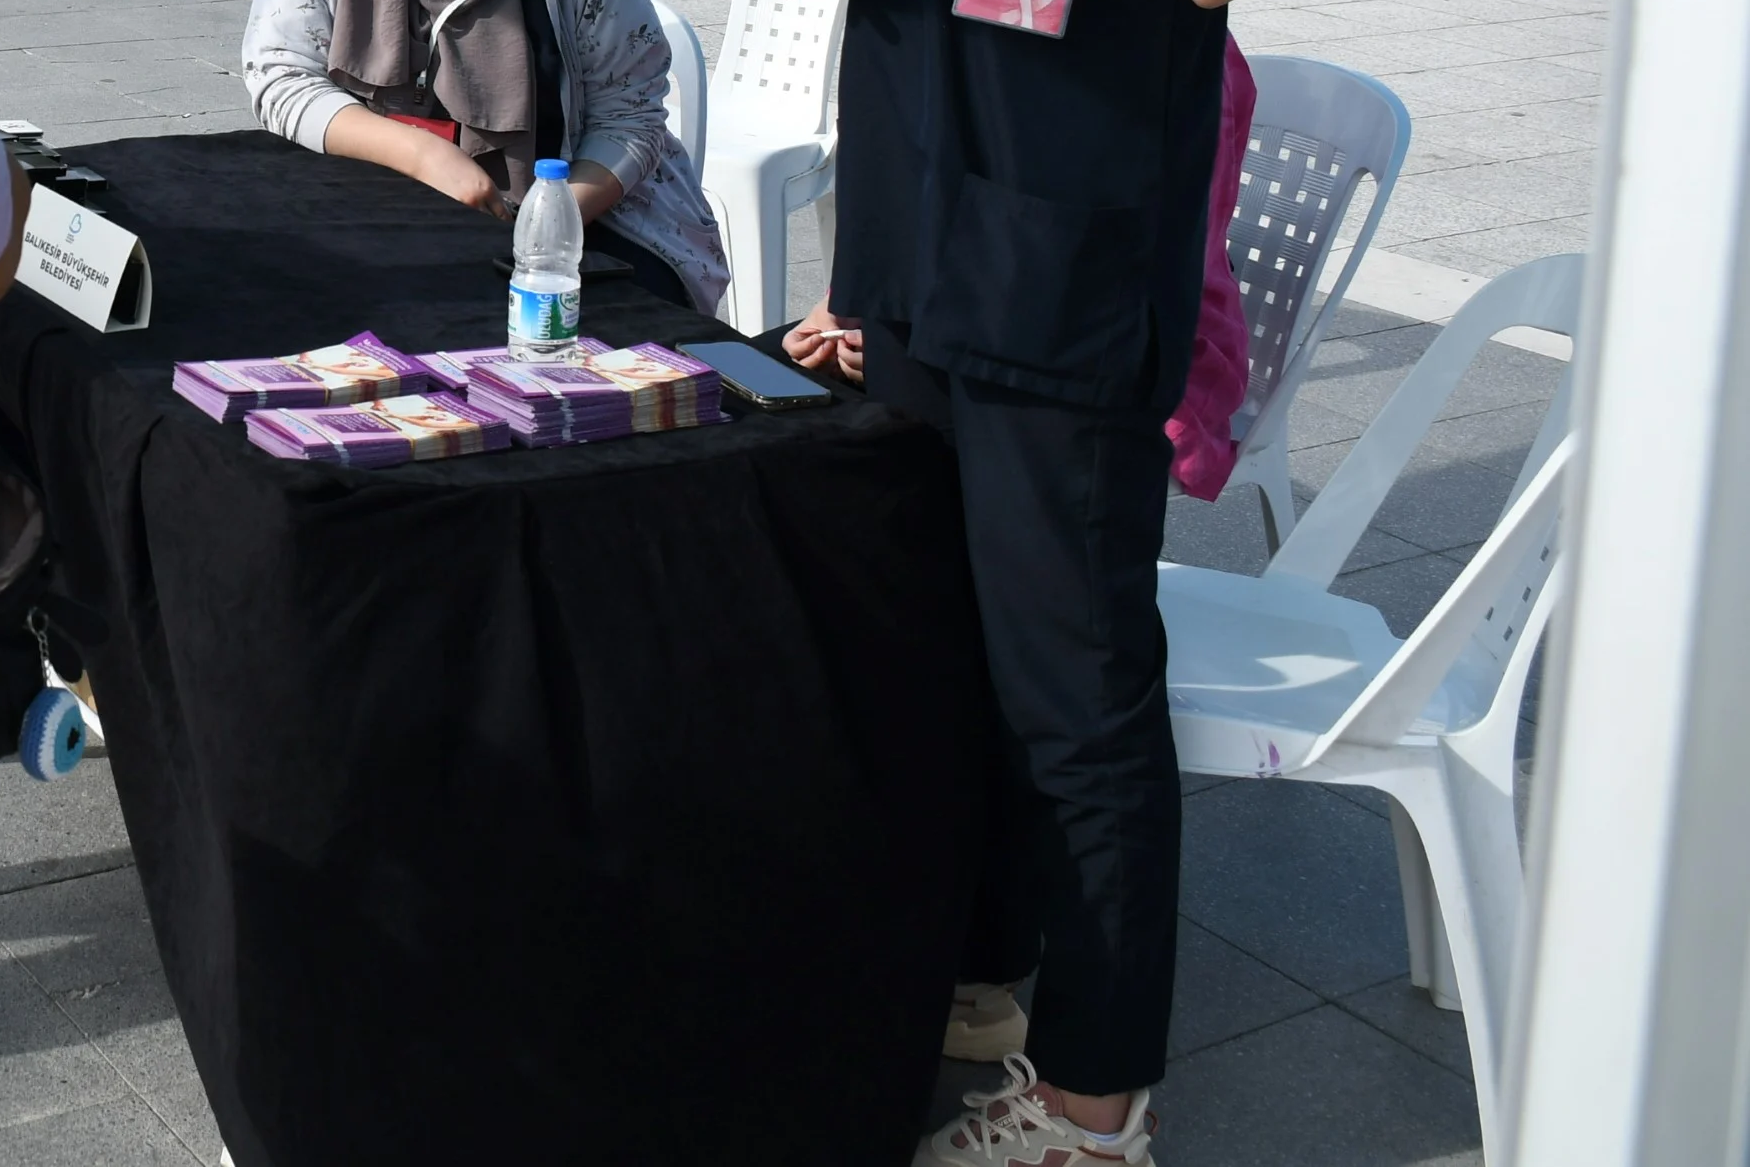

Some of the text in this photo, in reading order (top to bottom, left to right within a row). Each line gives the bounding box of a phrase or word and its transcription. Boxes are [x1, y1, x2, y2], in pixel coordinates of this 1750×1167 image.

[24, 231, 110, 289] BALIKESİR BÜYÜKŞEHİR
[39, 258, 84, 292] BELEDİYESİ
[536, 293, 553, 339] ULUDAĞ
